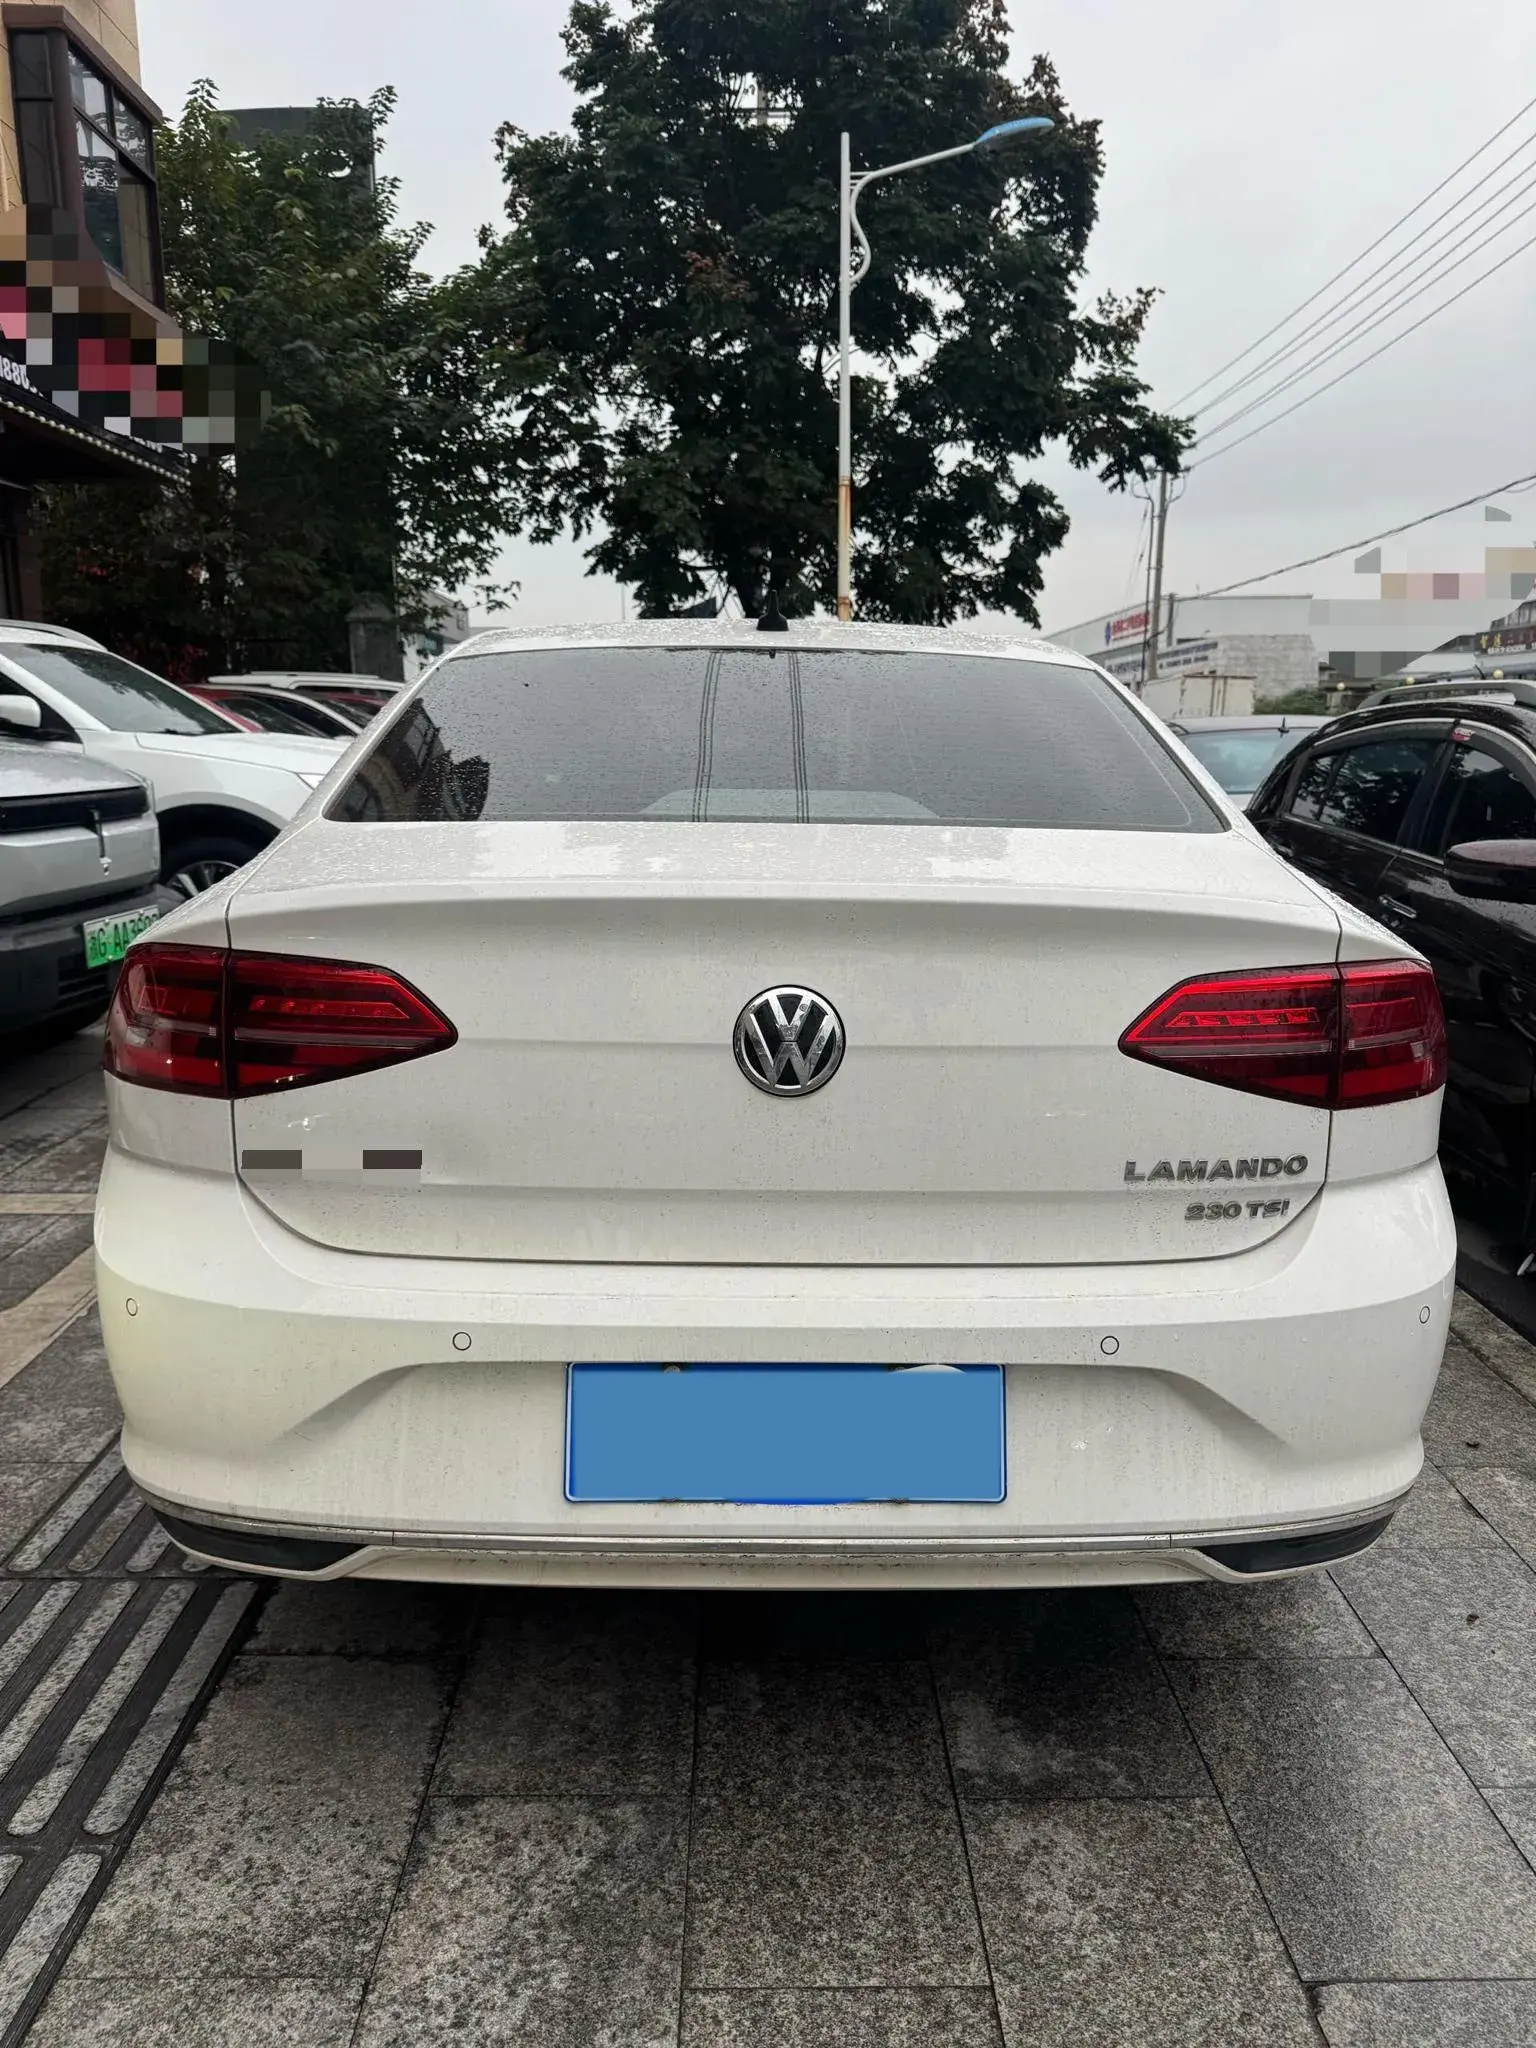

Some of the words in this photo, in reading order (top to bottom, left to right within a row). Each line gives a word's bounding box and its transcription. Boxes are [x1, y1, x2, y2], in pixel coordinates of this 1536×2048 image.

[1124, 1154, 1308, 1181] LAMANDO
[1184, 1202, 1242, 1220] 230
[1248, 1199, 1290, 1217] TSI
